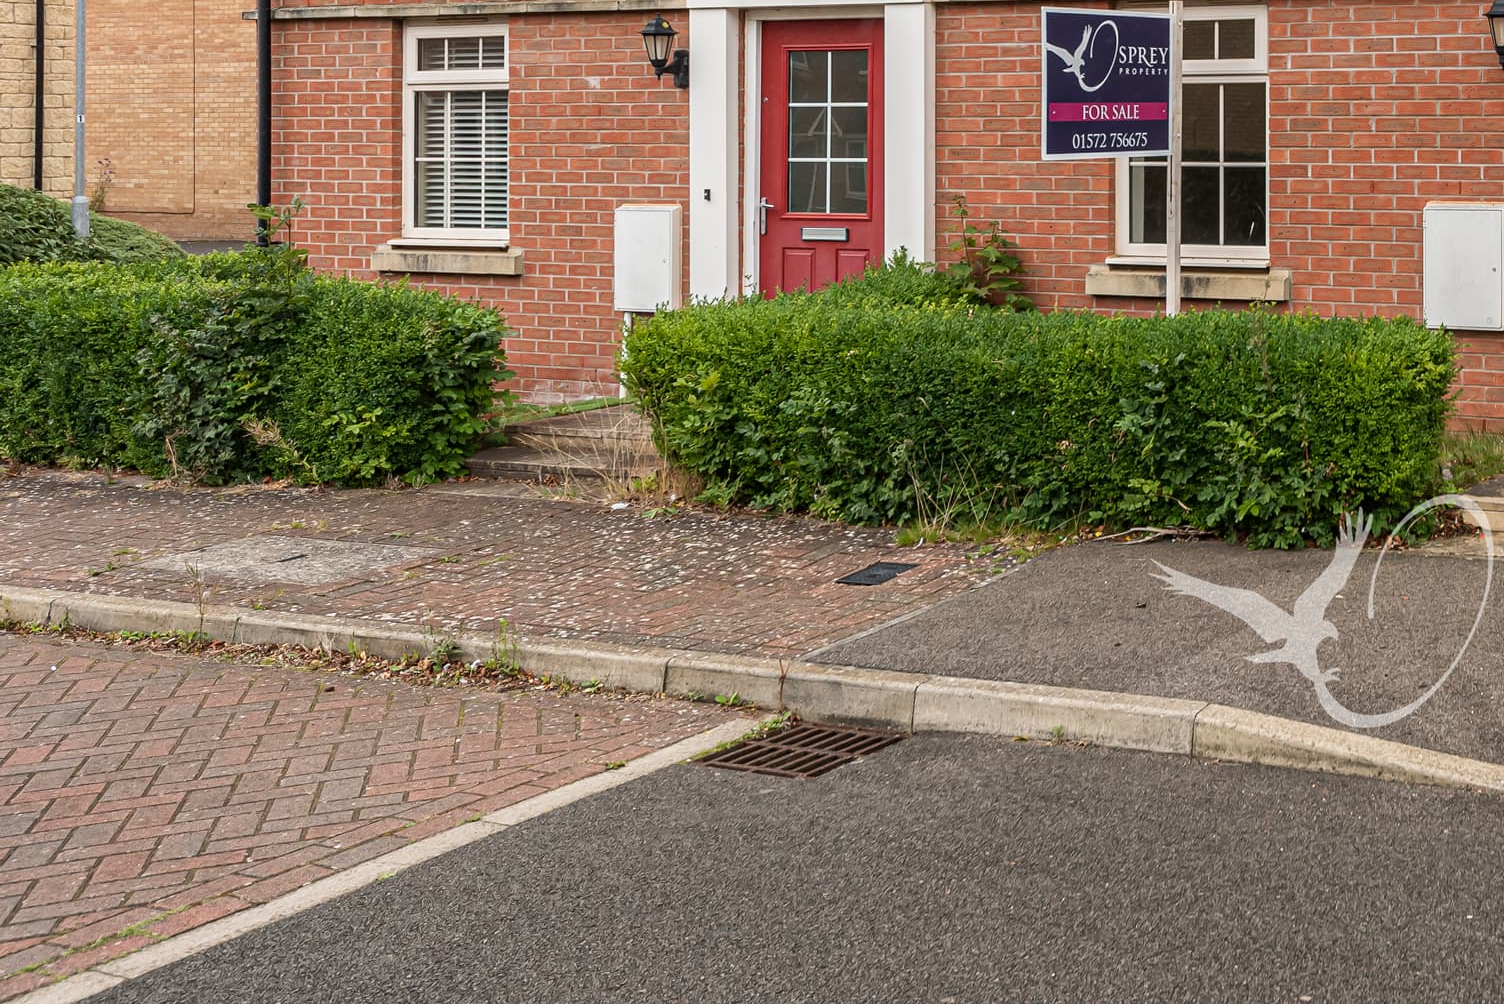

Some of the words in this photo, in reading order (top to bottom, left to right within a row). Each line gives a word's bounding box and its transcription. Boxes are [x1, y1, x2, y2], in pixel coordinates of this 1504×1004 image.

[1119, 67, 1169, 76] PROPERTY
[1082, 104, 1110, 120] FOR
[1112, 104, 1140, 120] SALE
[1072, 133, 1107, 149] 01572
[1109, 132, 1148, 148] 756675
